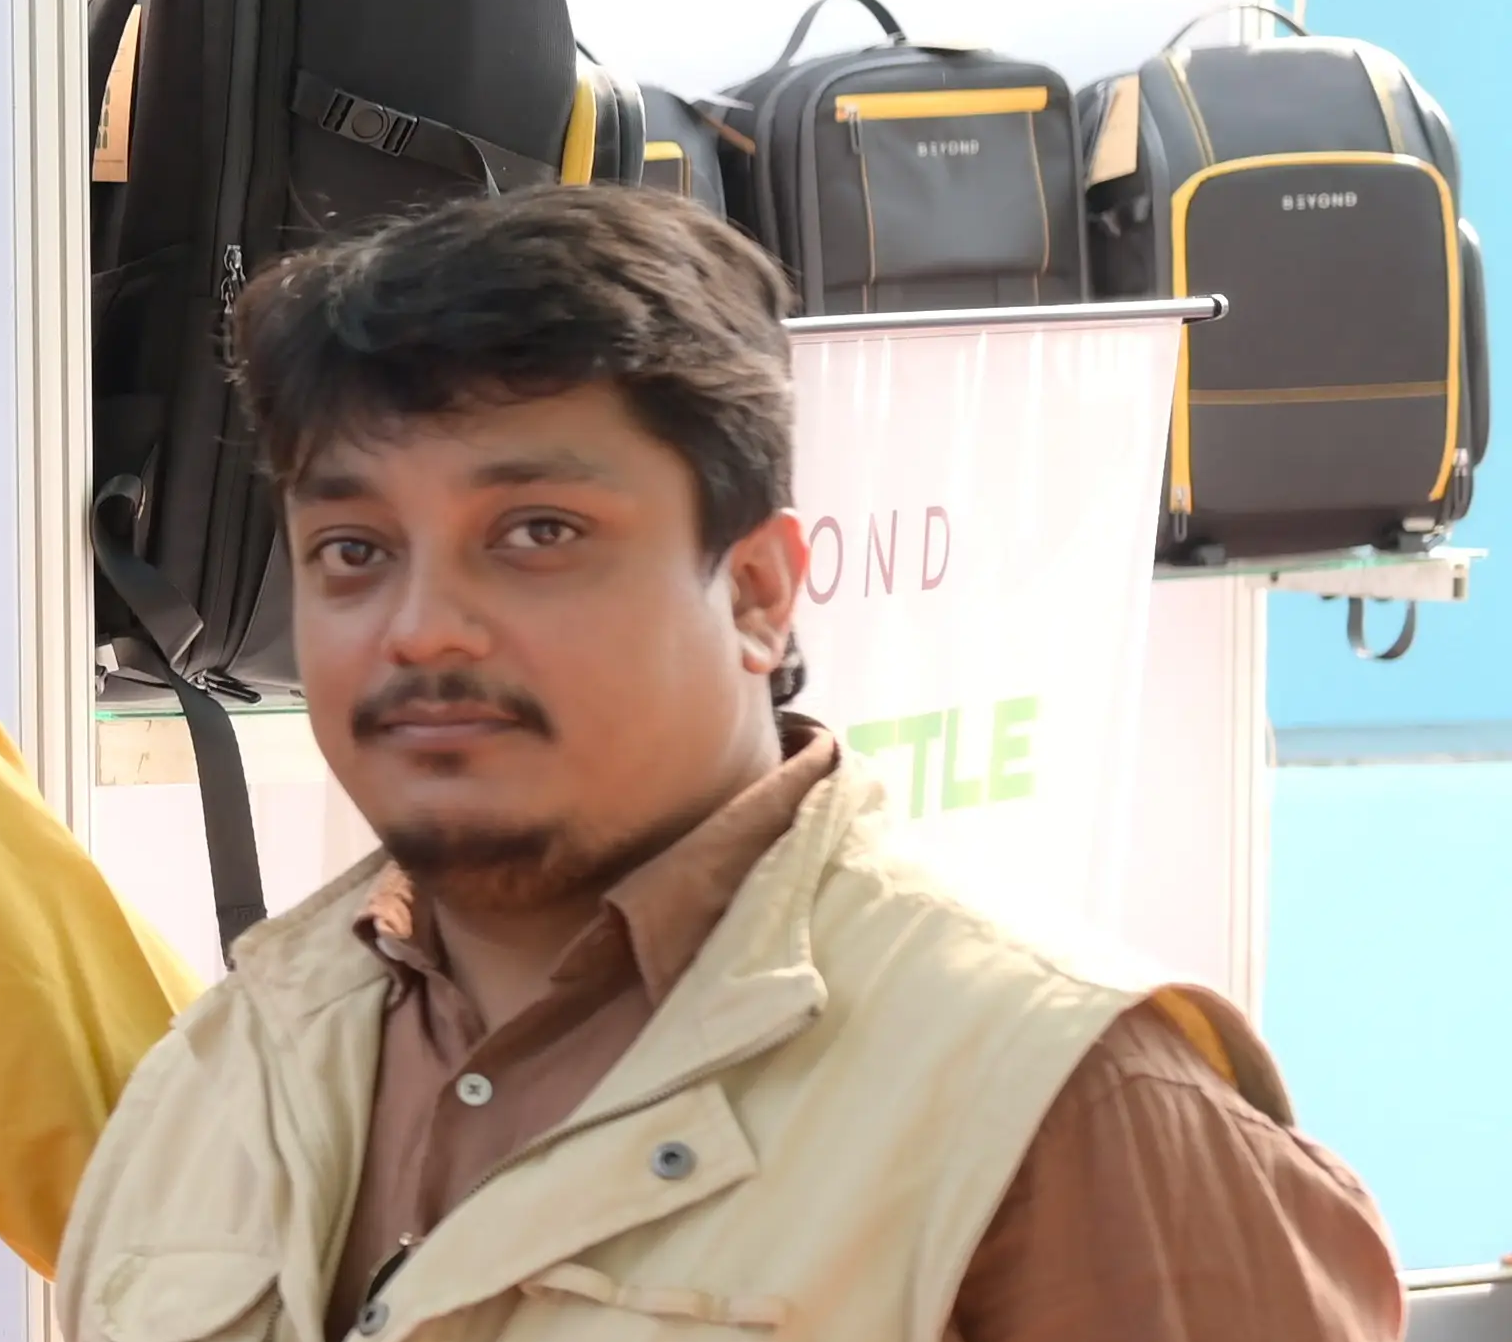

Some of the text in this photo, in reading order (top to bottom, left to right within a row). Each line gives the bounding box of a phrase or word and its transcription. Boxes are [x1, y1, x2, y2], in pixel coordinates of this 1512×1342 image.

[917, 139, 979, 157] BEYOND
[1281, 191, 1358, 210] BEYOND
[806, 505, 951, 605] OND
